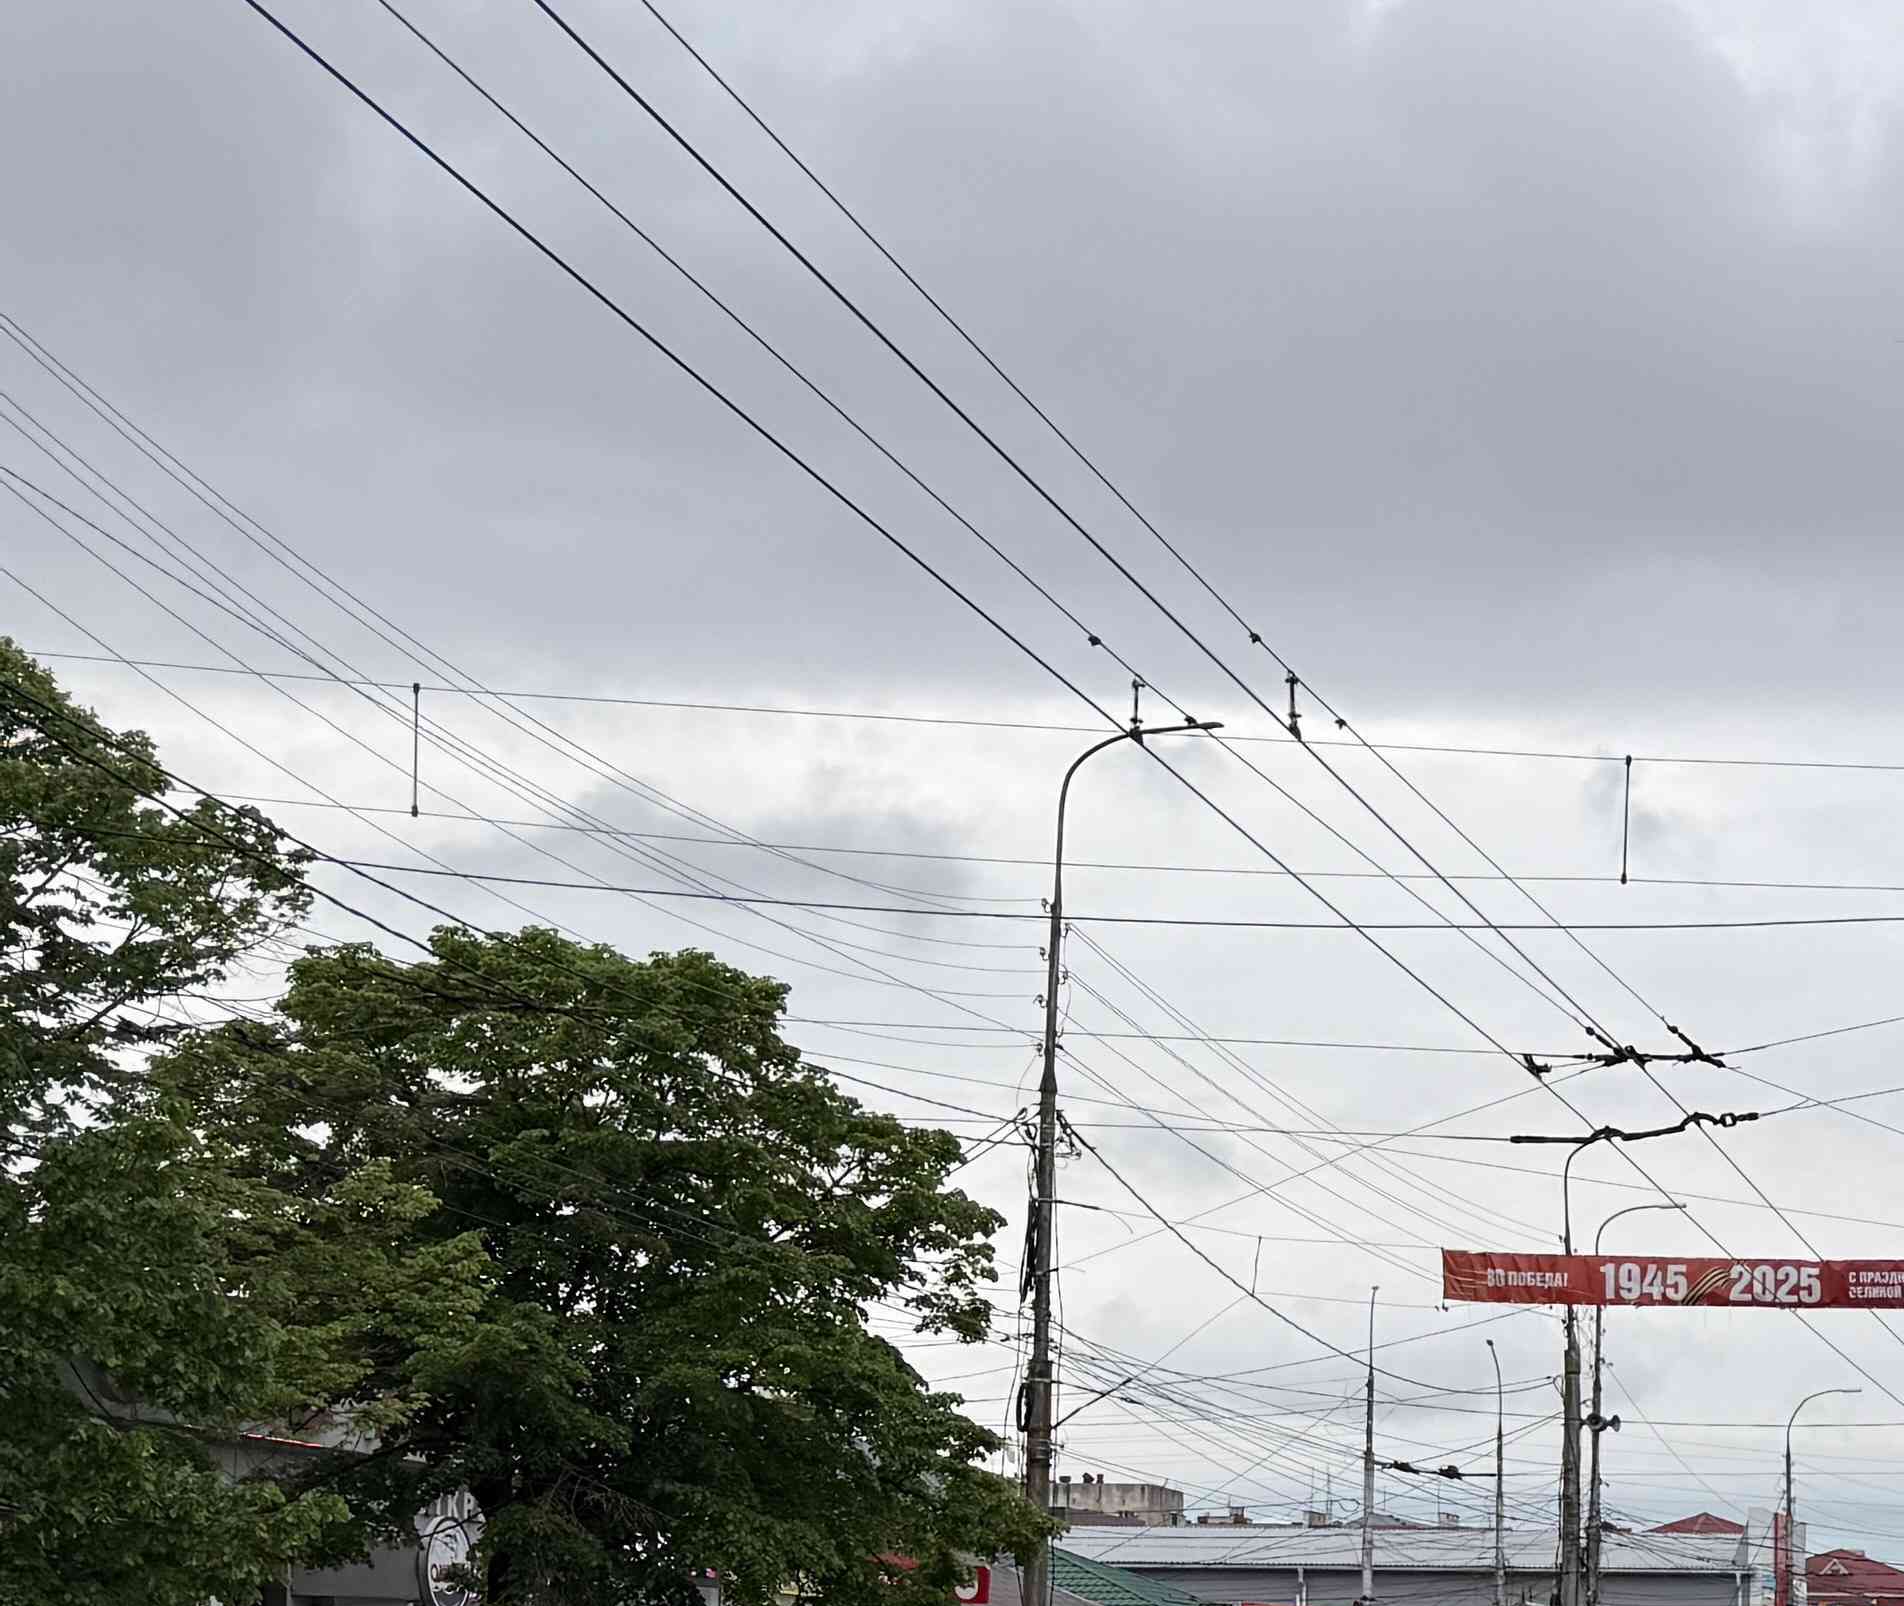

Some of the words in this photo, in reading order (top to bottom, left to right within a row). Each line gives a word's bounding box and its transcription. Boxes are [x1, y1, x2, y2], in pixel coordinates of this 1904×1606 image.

[1600, 1262, 1688, 1301] 1945
[1728, 1264, 1821, 1304] 2025
[1849, 1271, 1857, 1283] С
